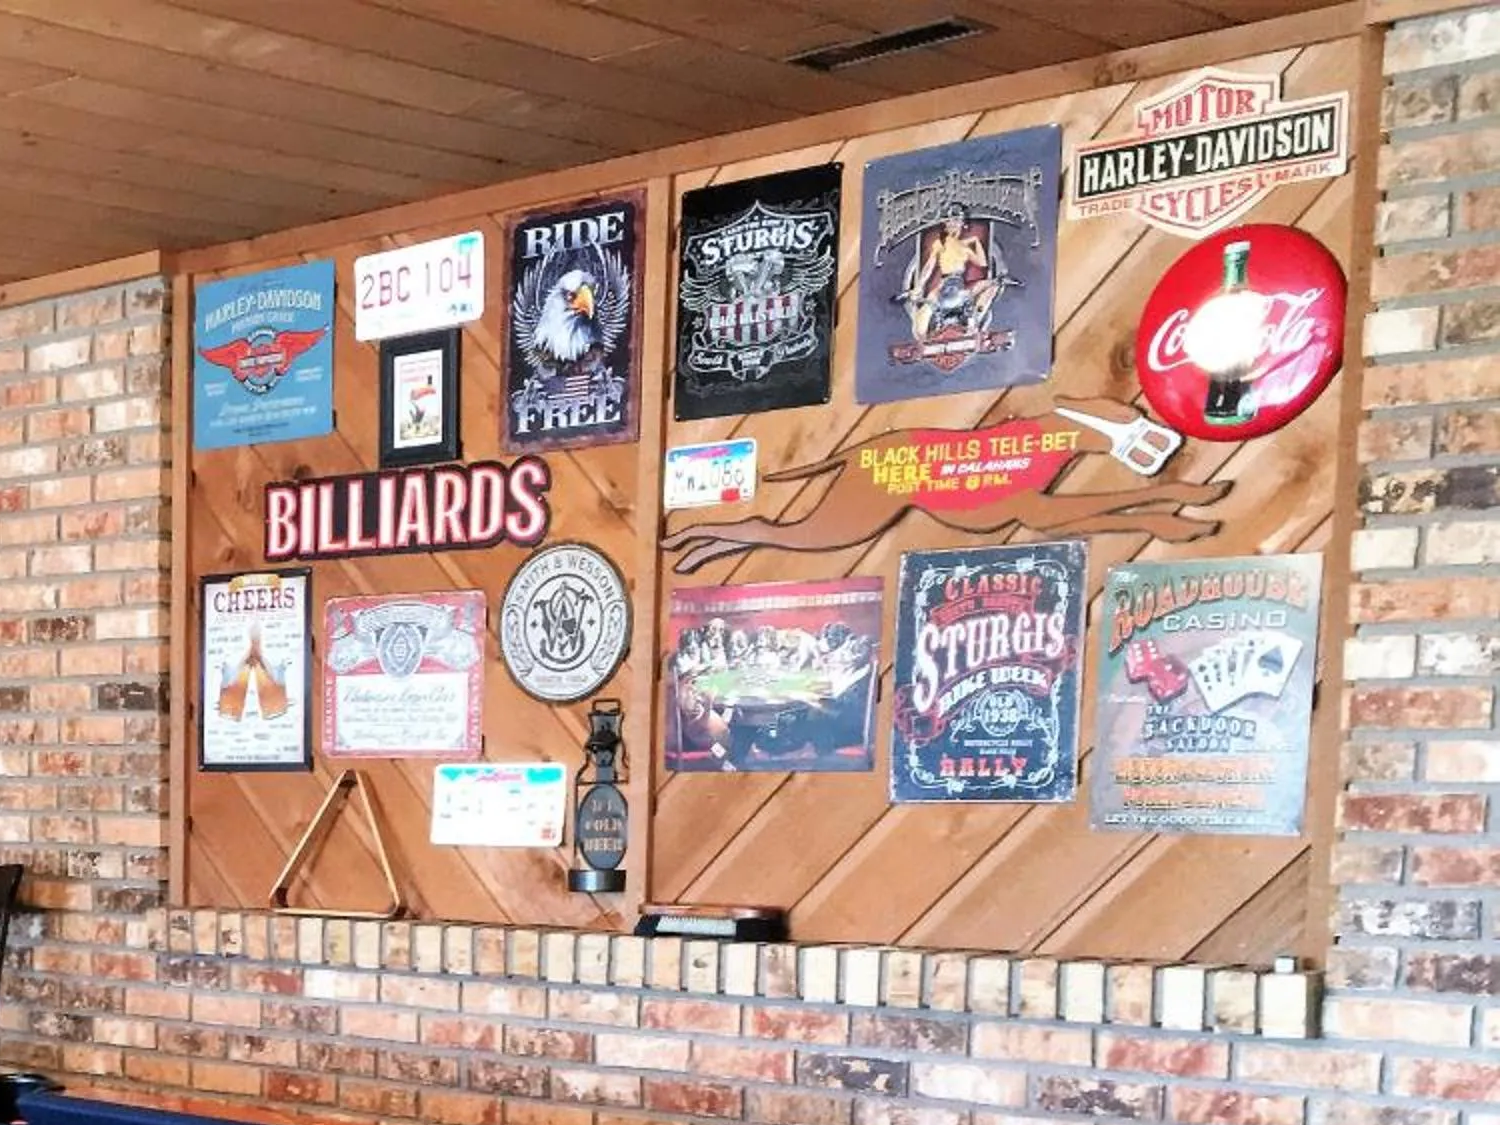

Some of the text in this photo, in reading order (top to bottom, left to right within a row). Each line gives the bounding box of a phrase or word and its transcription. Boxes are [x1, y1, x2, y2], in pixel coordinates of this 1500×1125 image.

[1151, 84, 1255, 130] MOTOR
[1082, 112, 1331, 193] HARLEY-DAVIDSON
[1275, 163, 1332, 181] MARK
[1079, 197, 1133, 217] TRADE
[1151, 178, 1254, 222] CYCLES
[522, 211, 626, 258] RIDE
[702, 219, 816, 264] STURGIS
[362, 250, 472, 310] 2BC 104
[205, 289, 322, 332] HARLEY-DAVIDSON
[515, 395, 621, 434] FREE
[861, 431, 1080, 468] BLACK HILLS TELE-BET
[873, 463, 931, 484] HERE
[887, 480, 922, 494] POST
[927, 476, 959, 493] TIME
[266, 461, 549, 556] BILLIARDS
[515, 560, 550, 605] SMITH
[566, 554, 615, 600] WESSON
[944, 573, 1043, 600] CLASSIC
[213, 587, 296, 614] CHEERS
[1162, 610, 1288, 632] CASINO
[913, 610, 1066, 713] STURGIS
[990, 666, 1047, 687] WEEK
